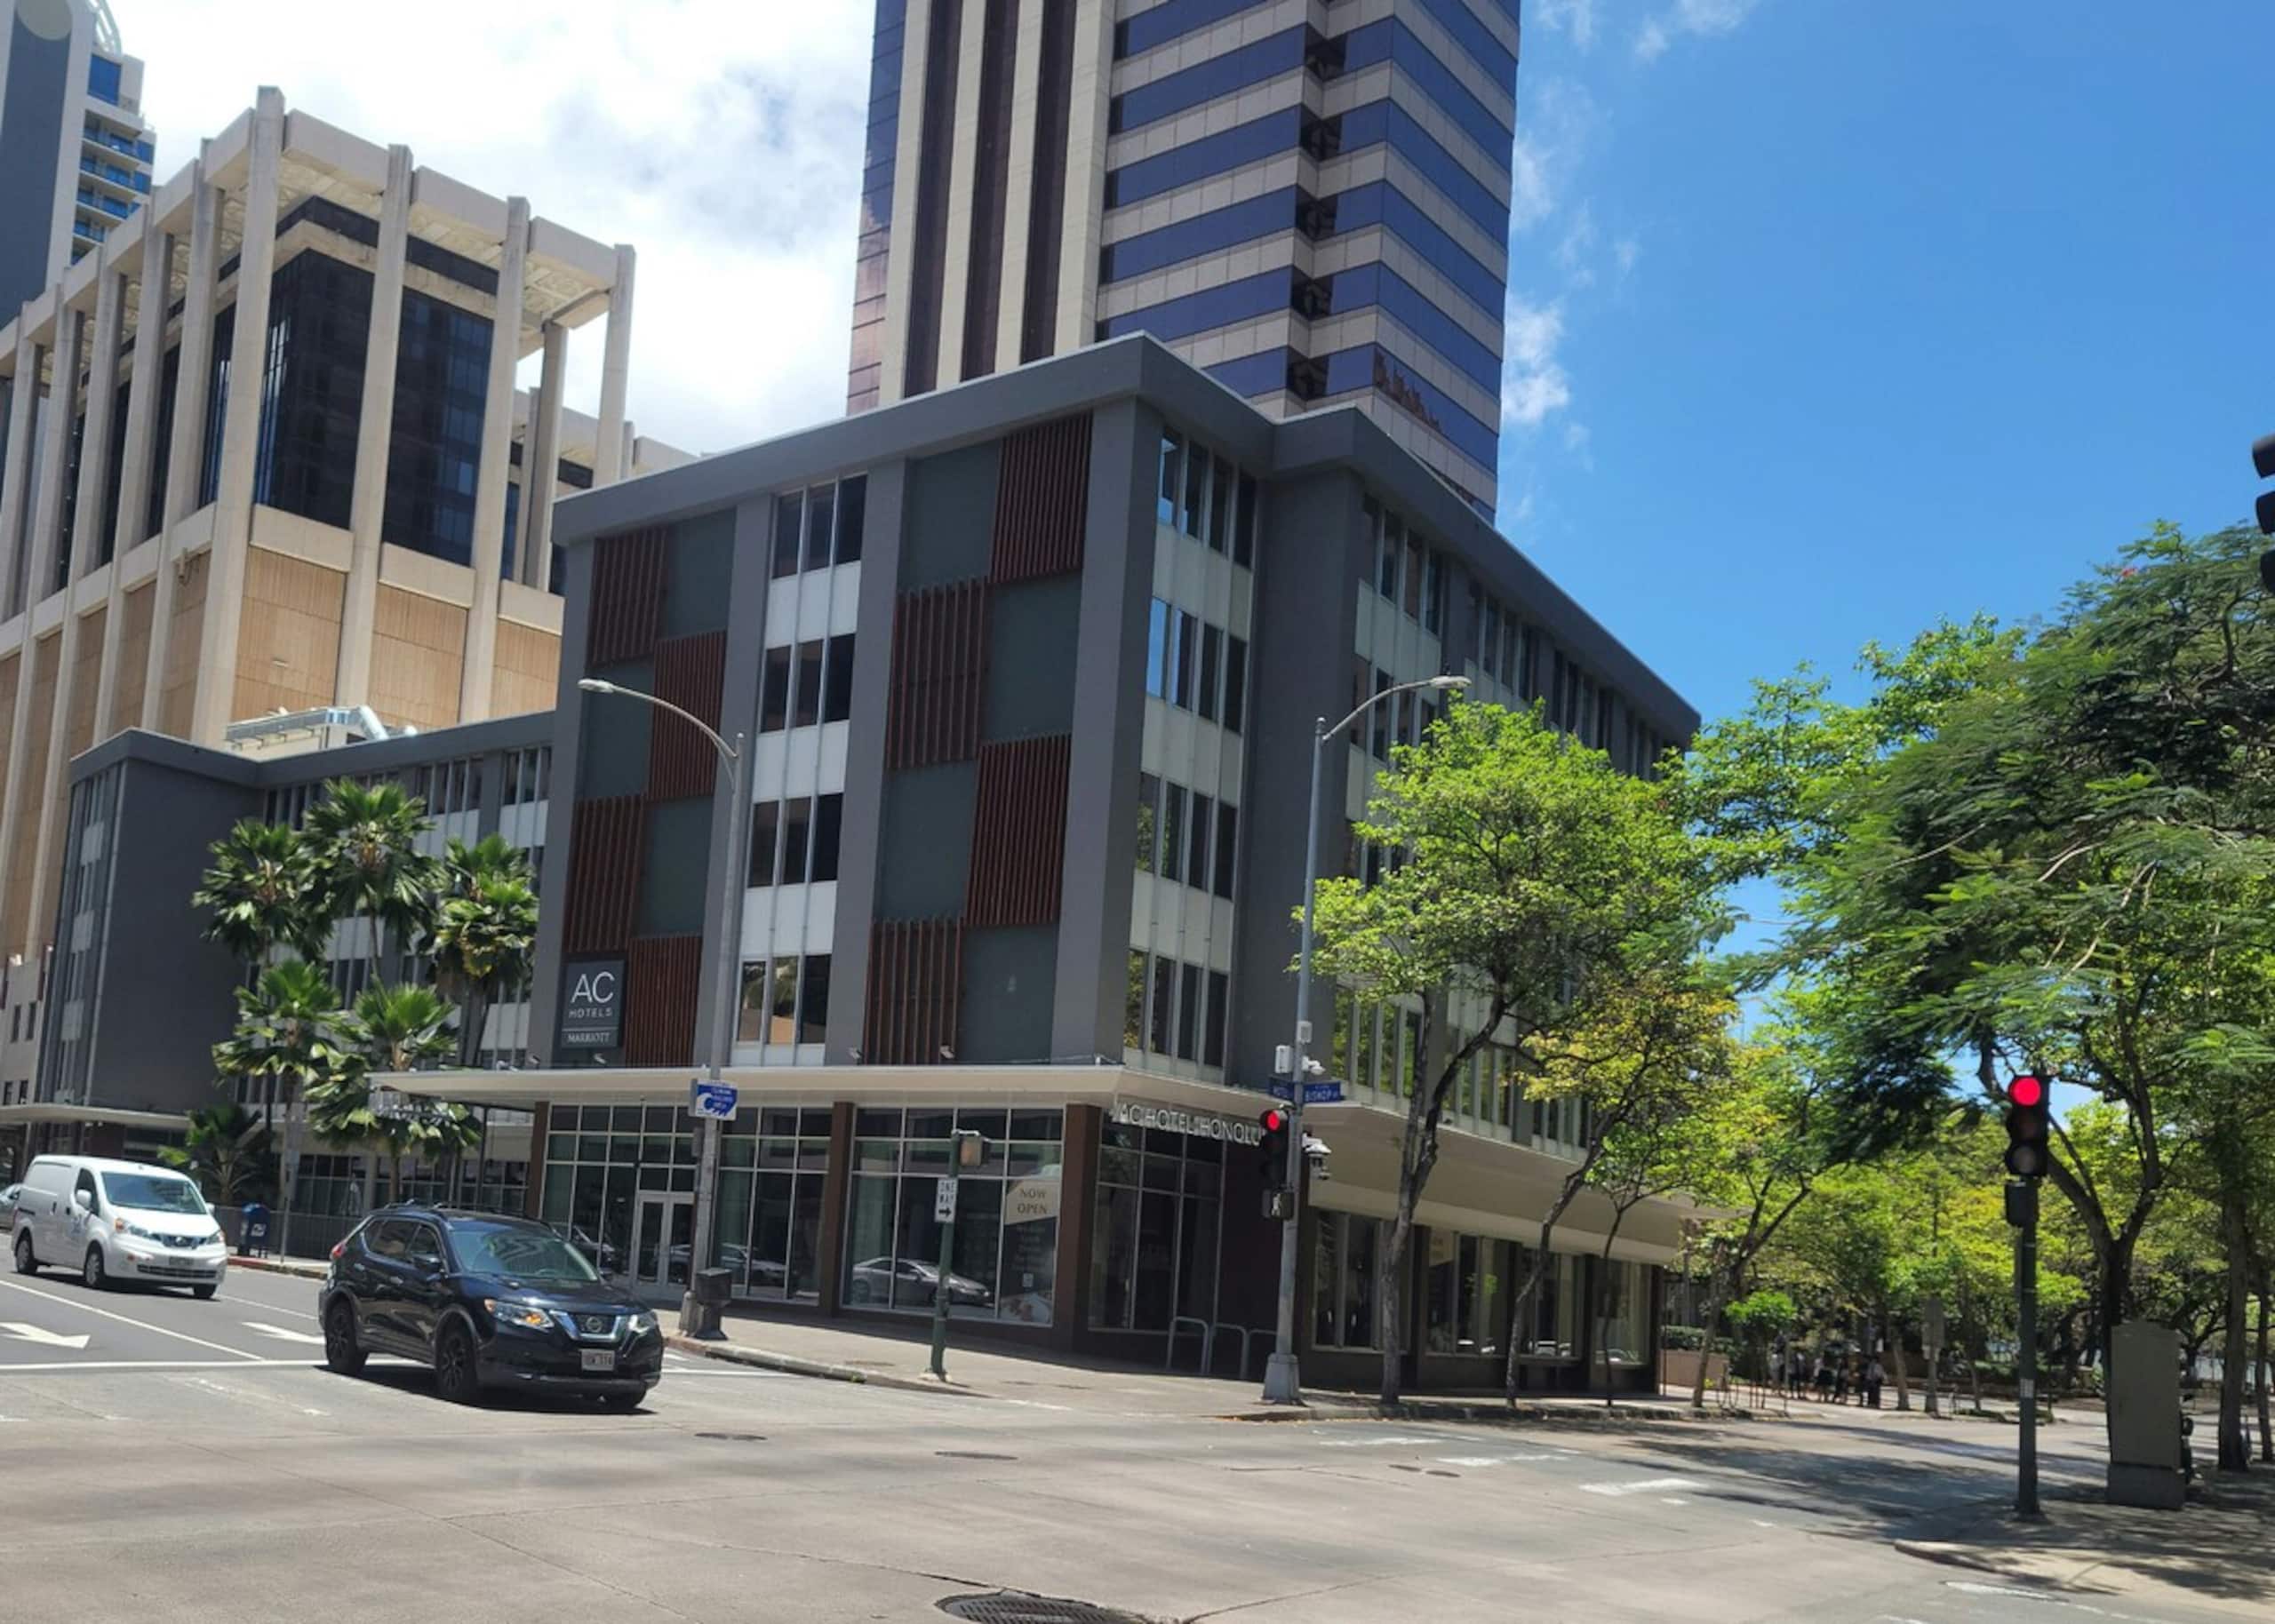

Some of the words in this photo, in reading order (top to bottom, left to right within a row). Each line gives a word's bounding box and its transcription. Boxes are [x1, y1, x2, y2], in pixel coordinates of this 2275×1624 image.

[571, 971, 615, 1003] AC
[569, 1007, 612, 1018] HOTELS
[568, 1032, 610, 1043] MARRIOTT
[1112, 1103, 1140, 1125] AC
[1141, 1108, 1194, 1134] HOTEL
[1197, 1116, 1265, 1146] HONOLU
[1018, 1188, 1047, 1198] NOW
[1017, 1203, 1047, 1214] OPEN
